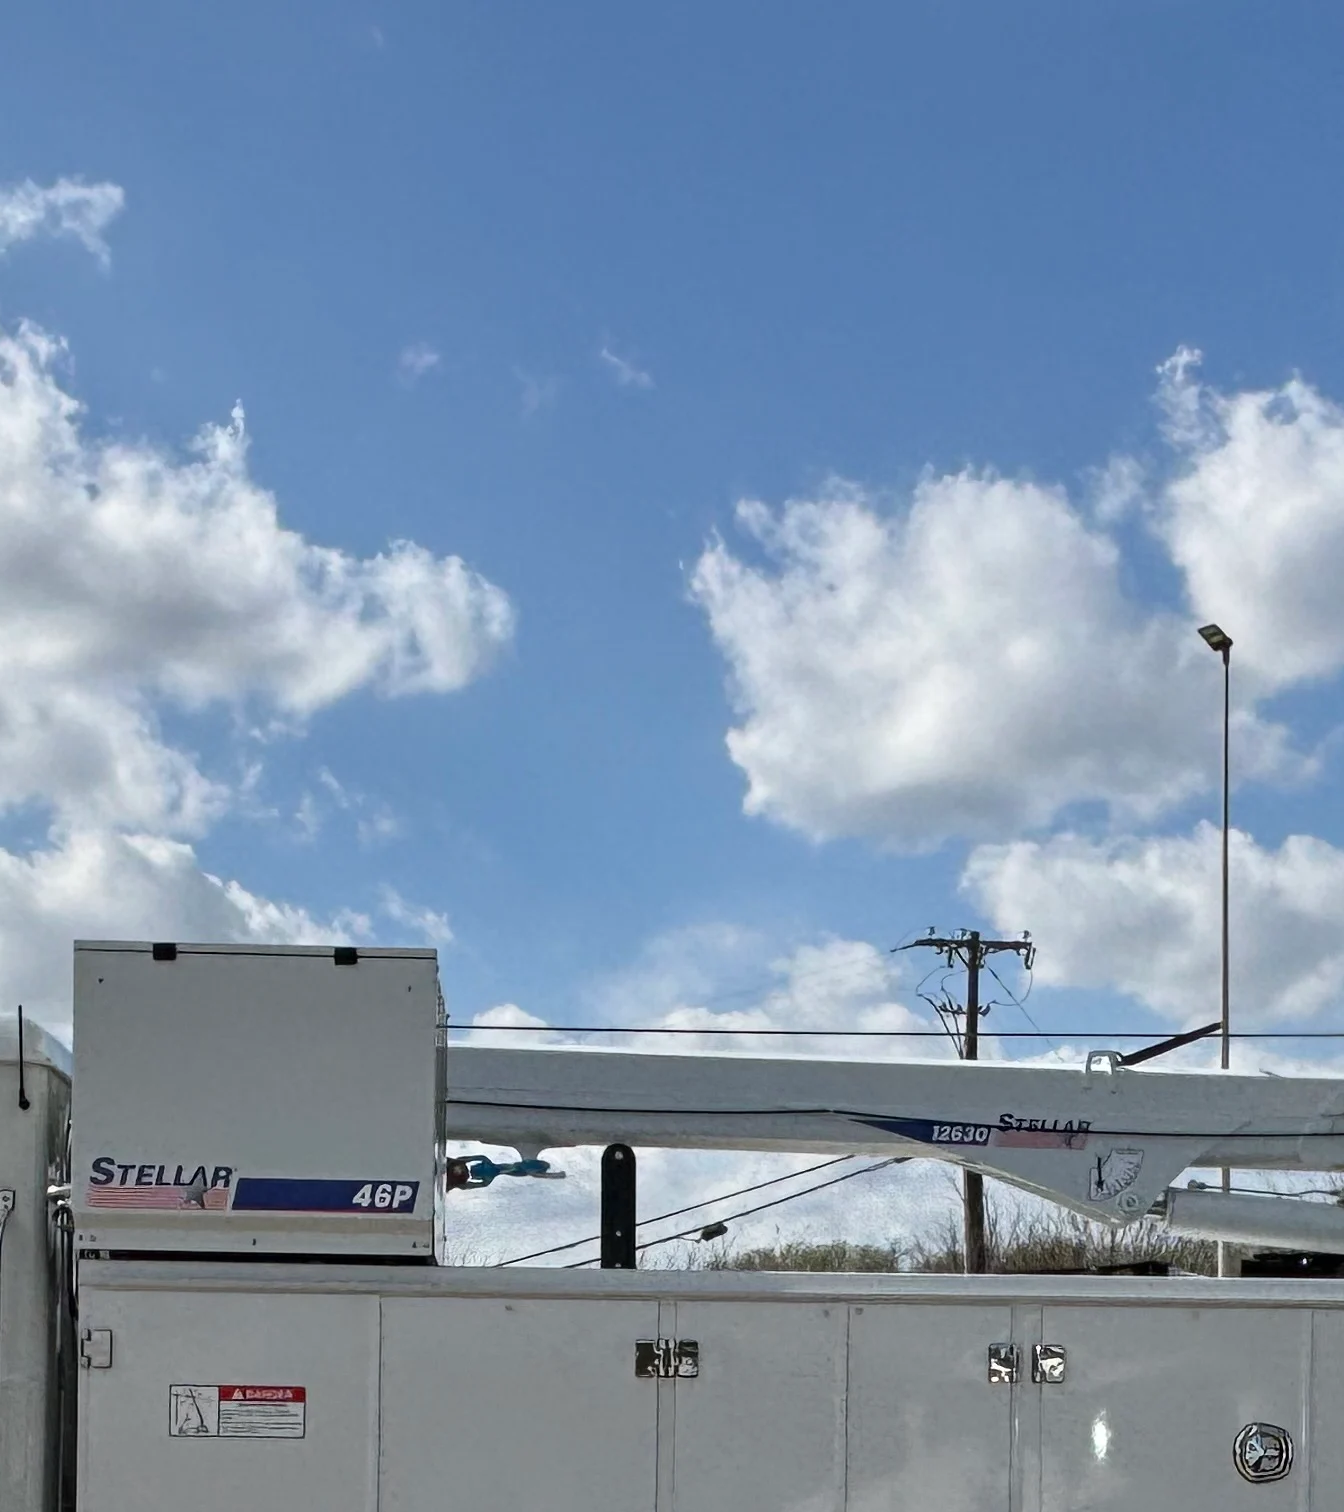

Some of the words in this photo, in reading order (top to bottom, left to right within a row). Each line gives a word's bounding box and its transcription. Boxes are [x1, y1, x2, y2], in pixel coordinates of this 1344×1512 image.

[931, 1125, 988, 1143] 12630
[89, 1157, 233, 1188] STELLAR
[351, 1182, 414, 1209] 46P
